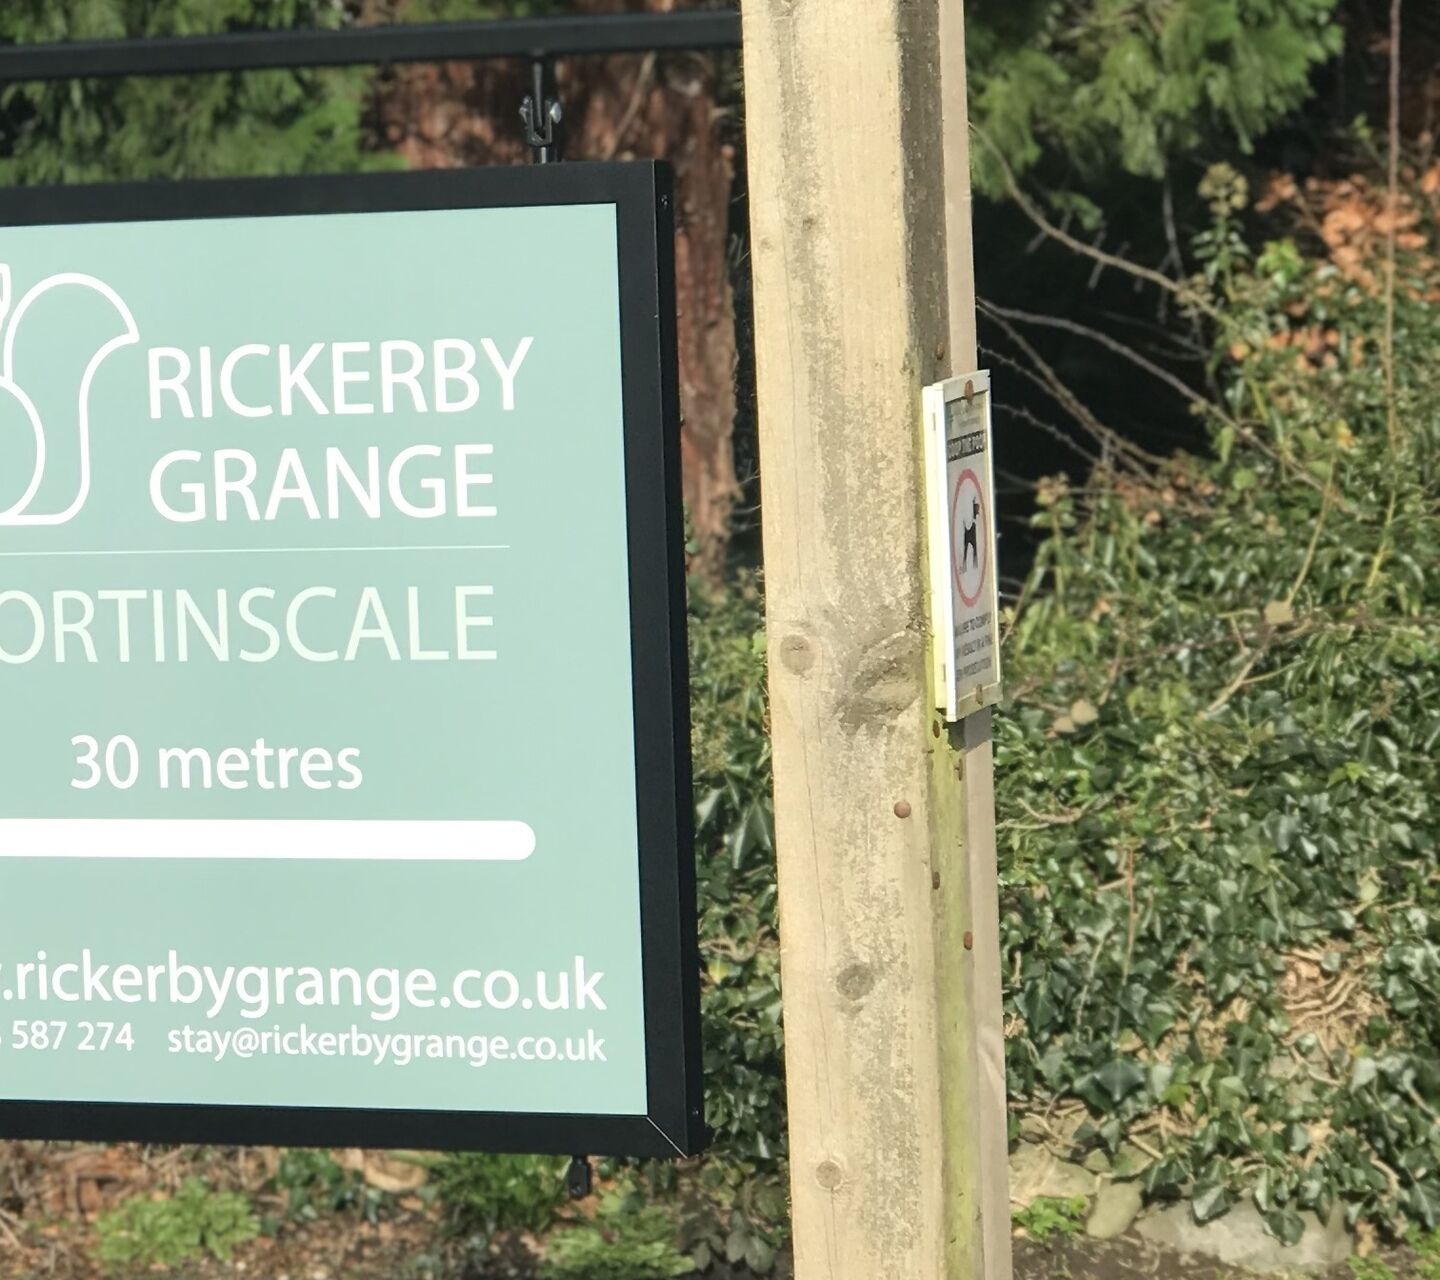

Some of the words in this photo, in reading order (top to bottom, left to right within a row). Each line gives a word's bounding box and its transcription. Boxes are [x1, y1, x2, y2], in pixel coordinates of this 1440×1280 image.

[148, 336, 534, 420] RICKERBY
[149, 443, 498, 523] GRANGE
[70, 734, 139, 791] 30
[158, 736, 363, 791] metres
[11, 1019, 68, 1050] 587
[77, 1021, 135, 1052] 274
[167, 1022, 608, 1068] stay@rickerbygrange.co.uk
